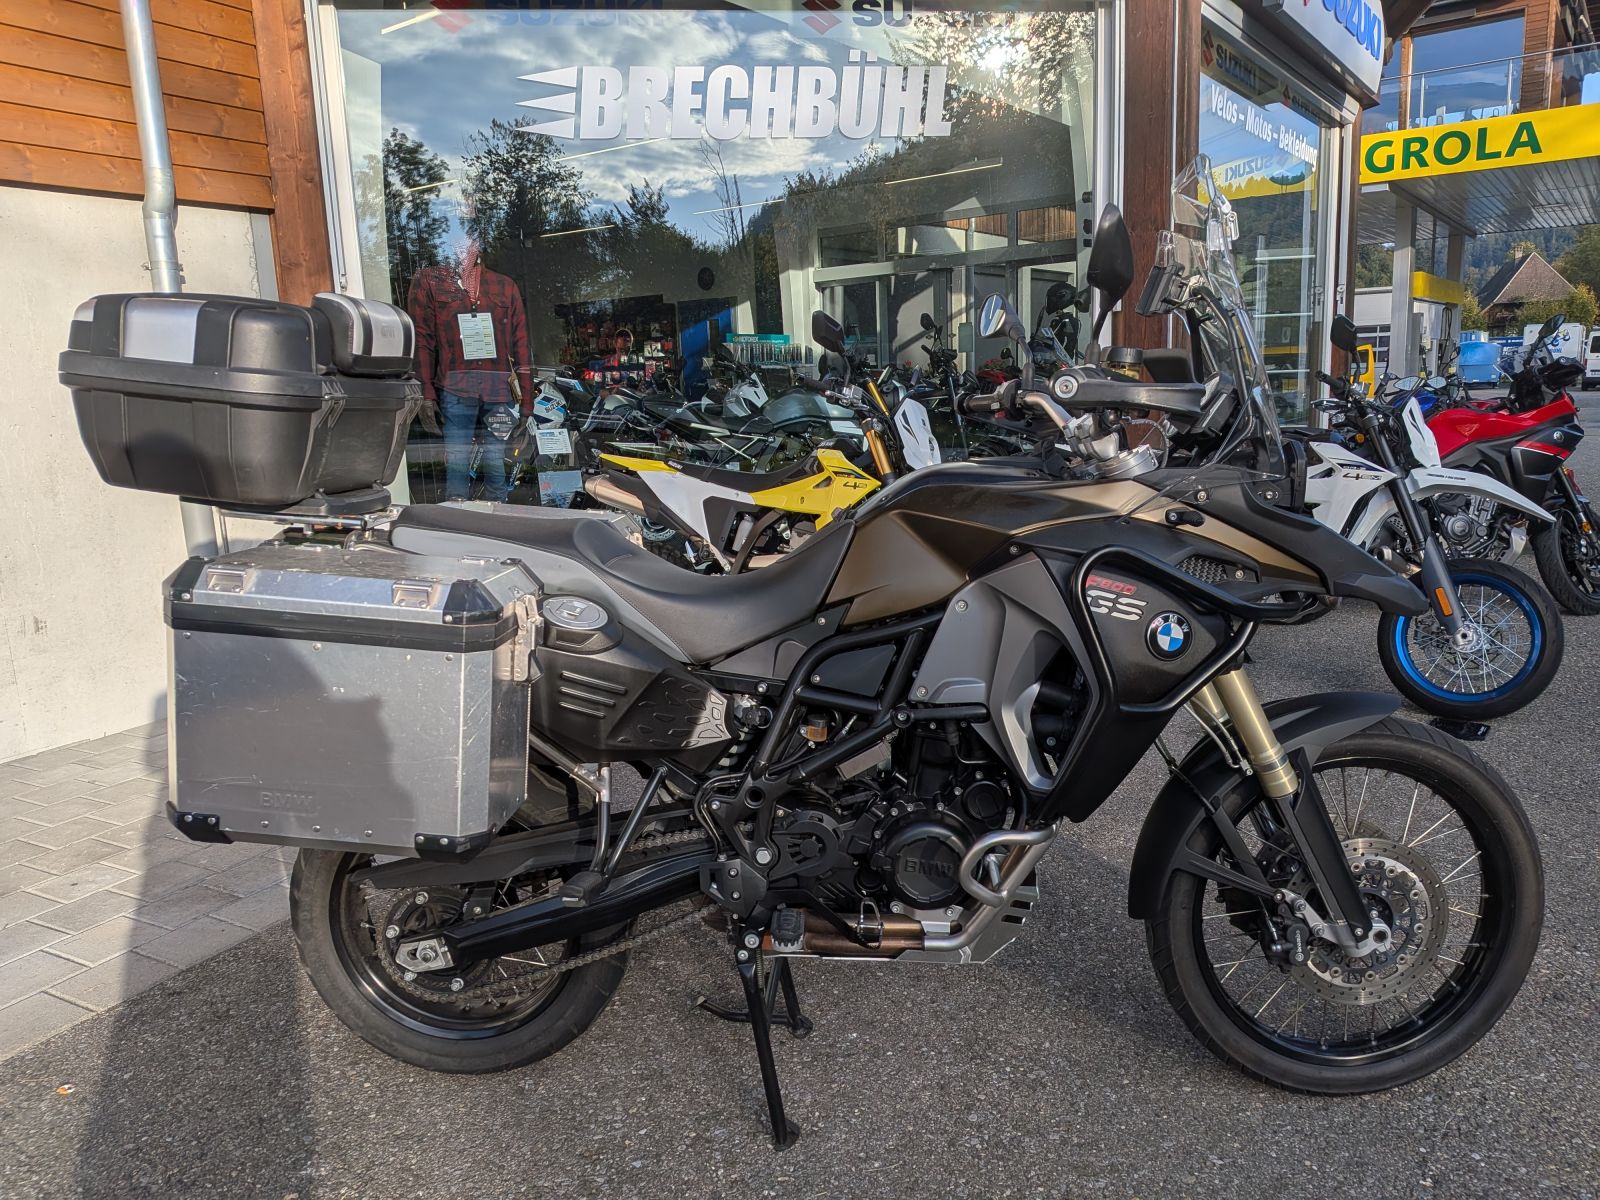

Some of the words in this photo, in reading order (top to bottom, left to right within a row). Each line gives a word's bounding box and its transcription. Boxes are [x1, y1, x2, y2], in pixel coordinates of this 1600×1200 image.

[580, 49, 951, 140] BRECHBÜHL
[1211, 83, 1237, 124] Velos
[1246, 105, 1272, 143] Motos
[1279, 124, 1318, 173] Bekleidung
[1364, 120, 1543, 174] GROLA
[1087, 590, 1148, 620] GS
[1151, 613, 1190, 633] BMW
[904, 857, 954, 878] BMW
